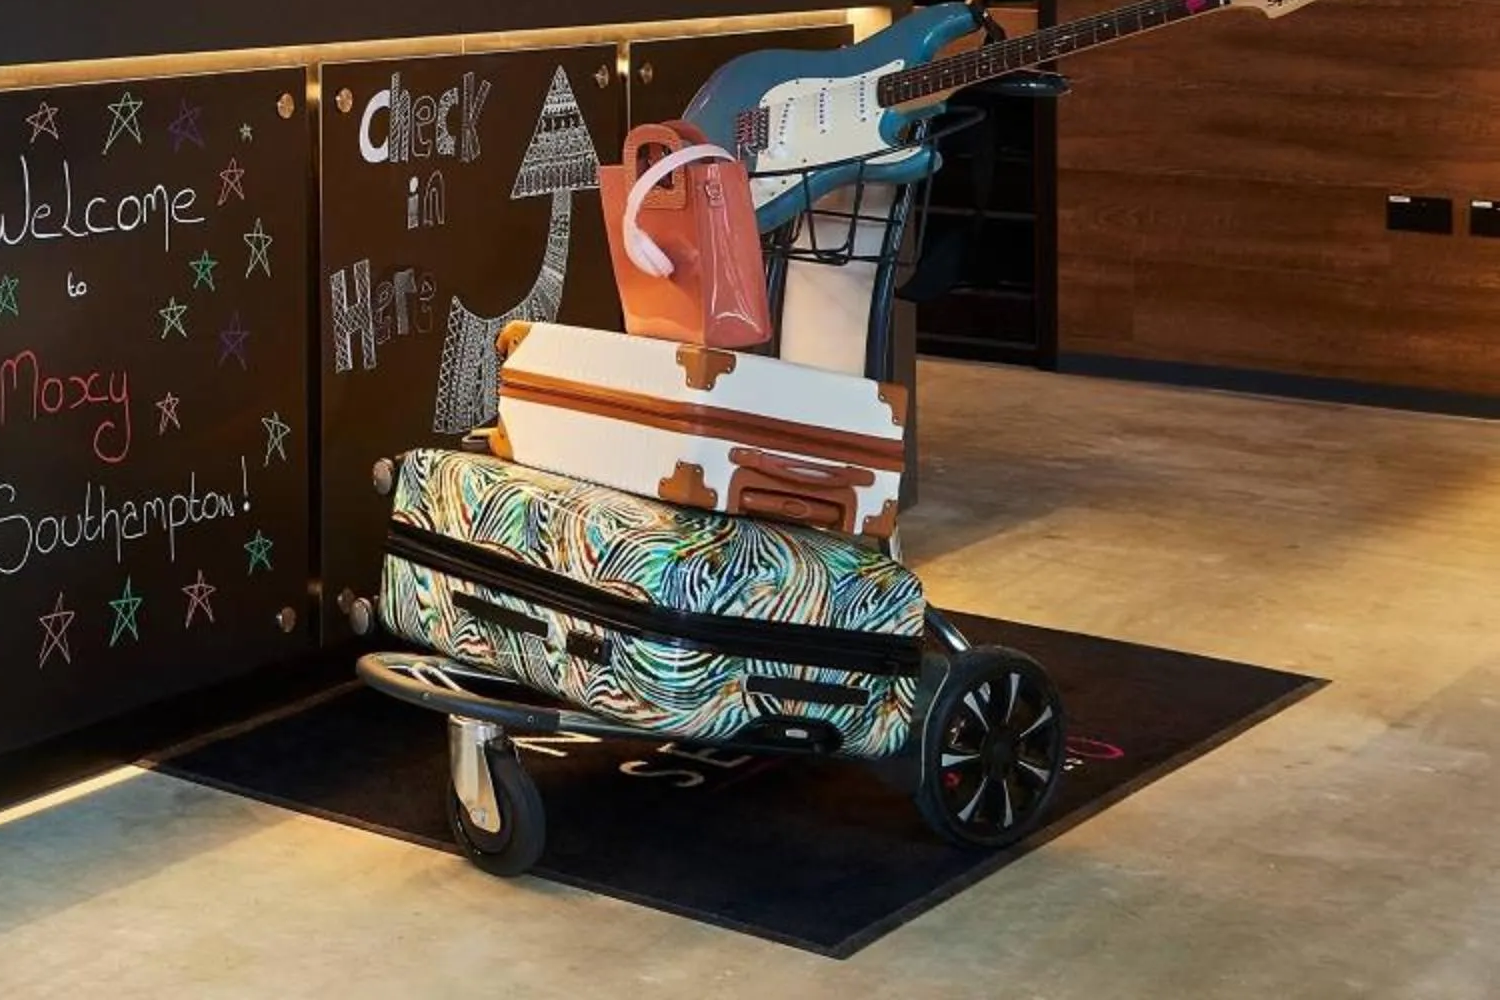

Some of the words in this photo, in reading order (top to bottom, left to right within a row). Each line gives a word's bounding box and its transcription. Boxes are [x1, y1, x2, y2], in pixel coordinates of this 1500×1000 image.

[407, 169, 446, 230] in
[67, 270, 88, 298] to
[329, 258, 437, 374] Here
[0, 349, 131, 464] Moxy
